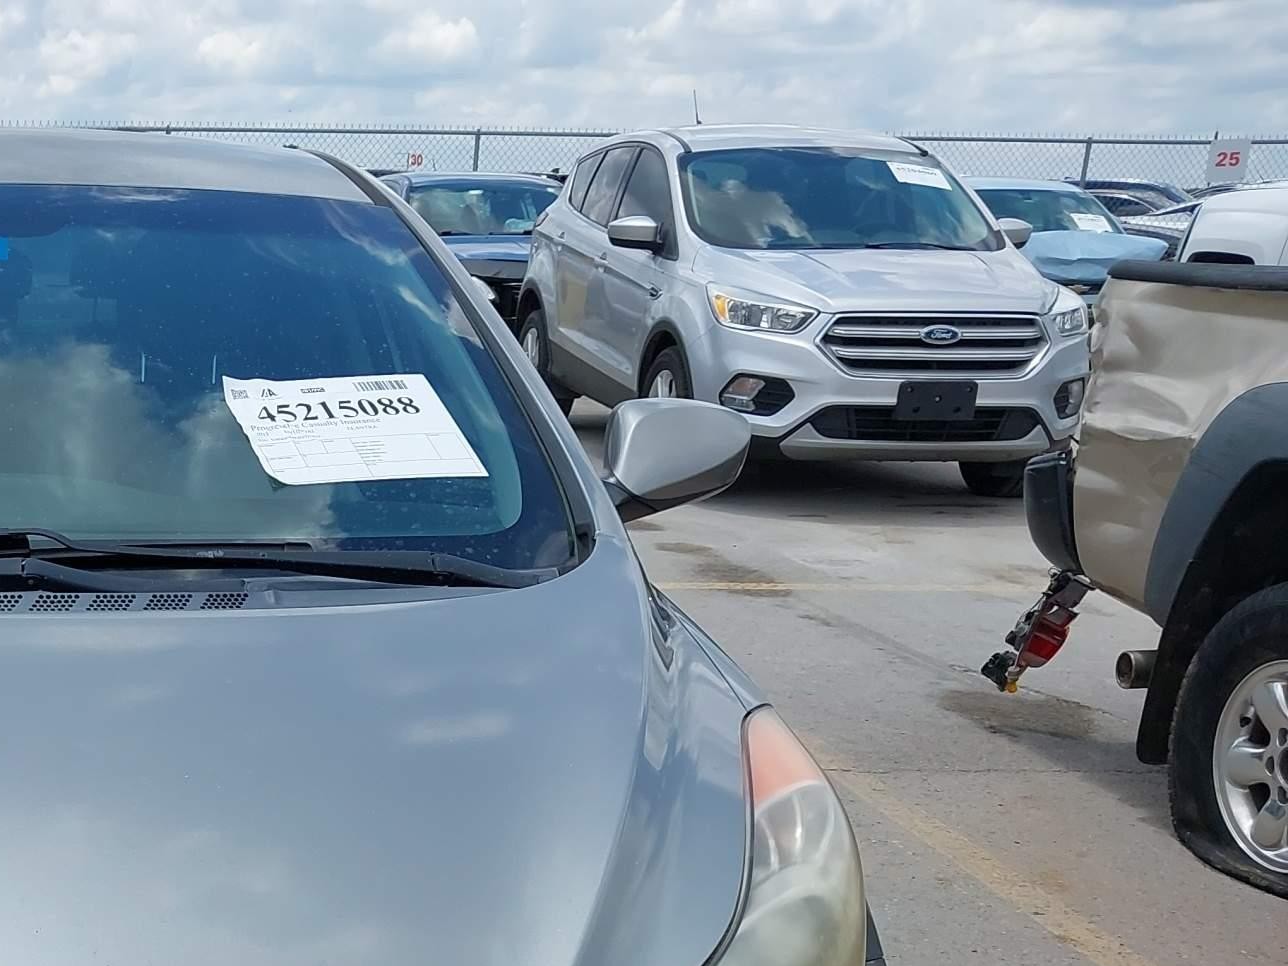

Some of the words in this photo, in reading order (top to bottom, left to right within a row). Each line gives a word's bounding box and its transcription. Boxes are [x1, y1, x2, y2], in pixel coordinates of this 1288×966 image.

[410, 153, 423, 166] 30
[1215, 151, 1241, 167] 25
[257, 396, 421, 422] 45215088
